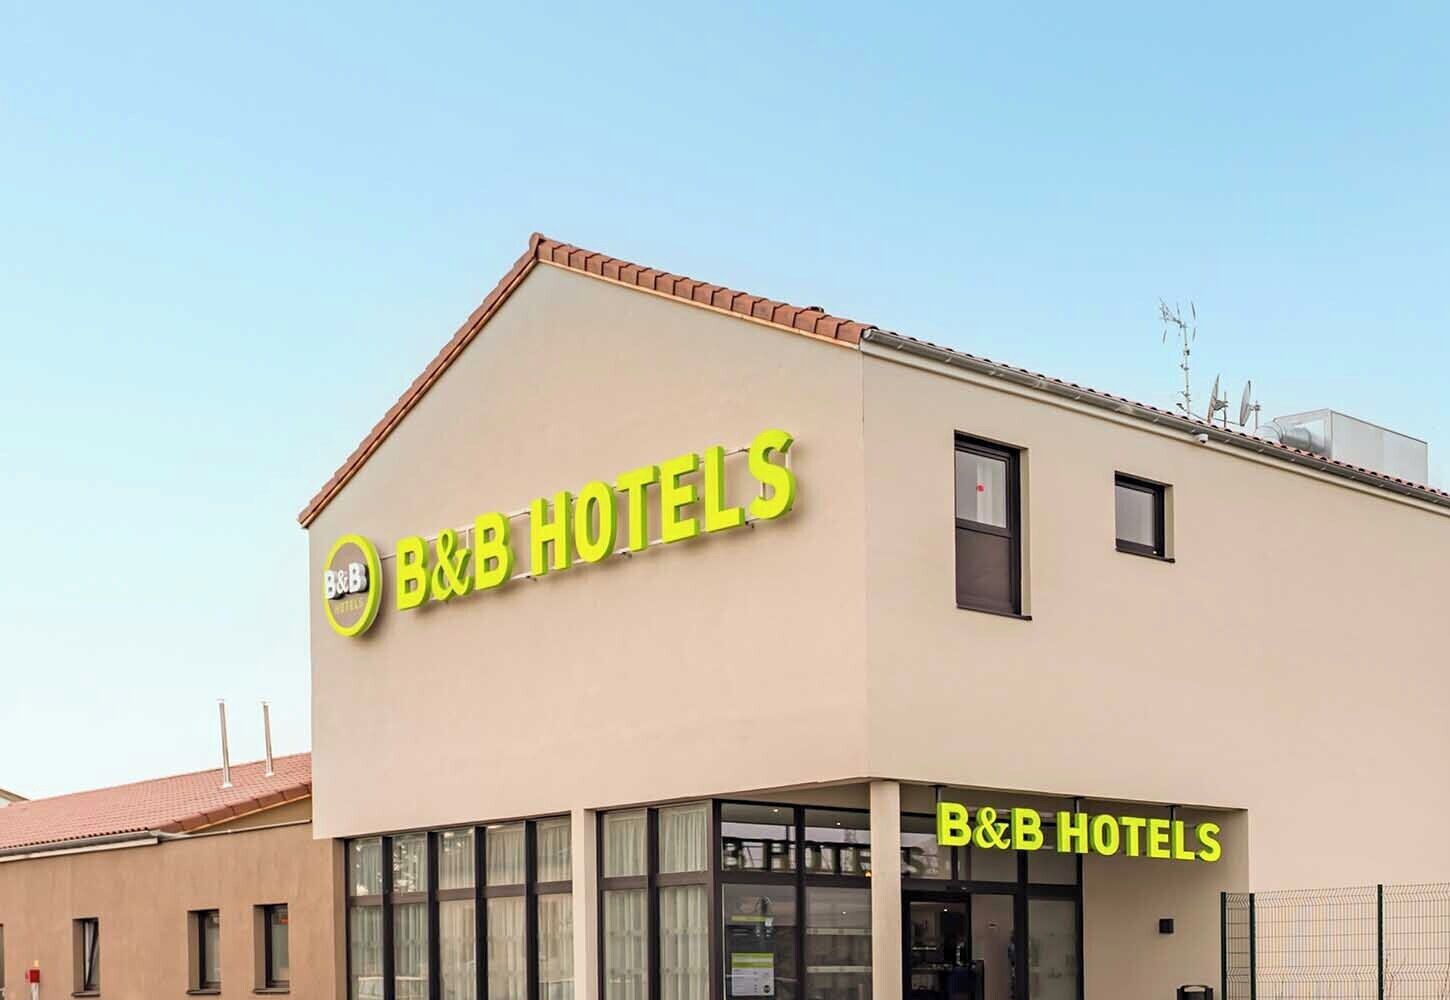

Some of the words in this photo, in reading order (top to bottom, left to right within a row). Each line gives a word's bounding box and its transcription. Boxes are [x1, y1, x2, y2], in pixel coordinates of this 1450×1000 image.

[397, 512, 513, 611] B&B
[529, 428, 797, 576] HOTELS
[324, 562, 367, 600] B&B
[937, 802, 1044, 850] B&B
[1057, 811, 1222, 862] HOTELS
